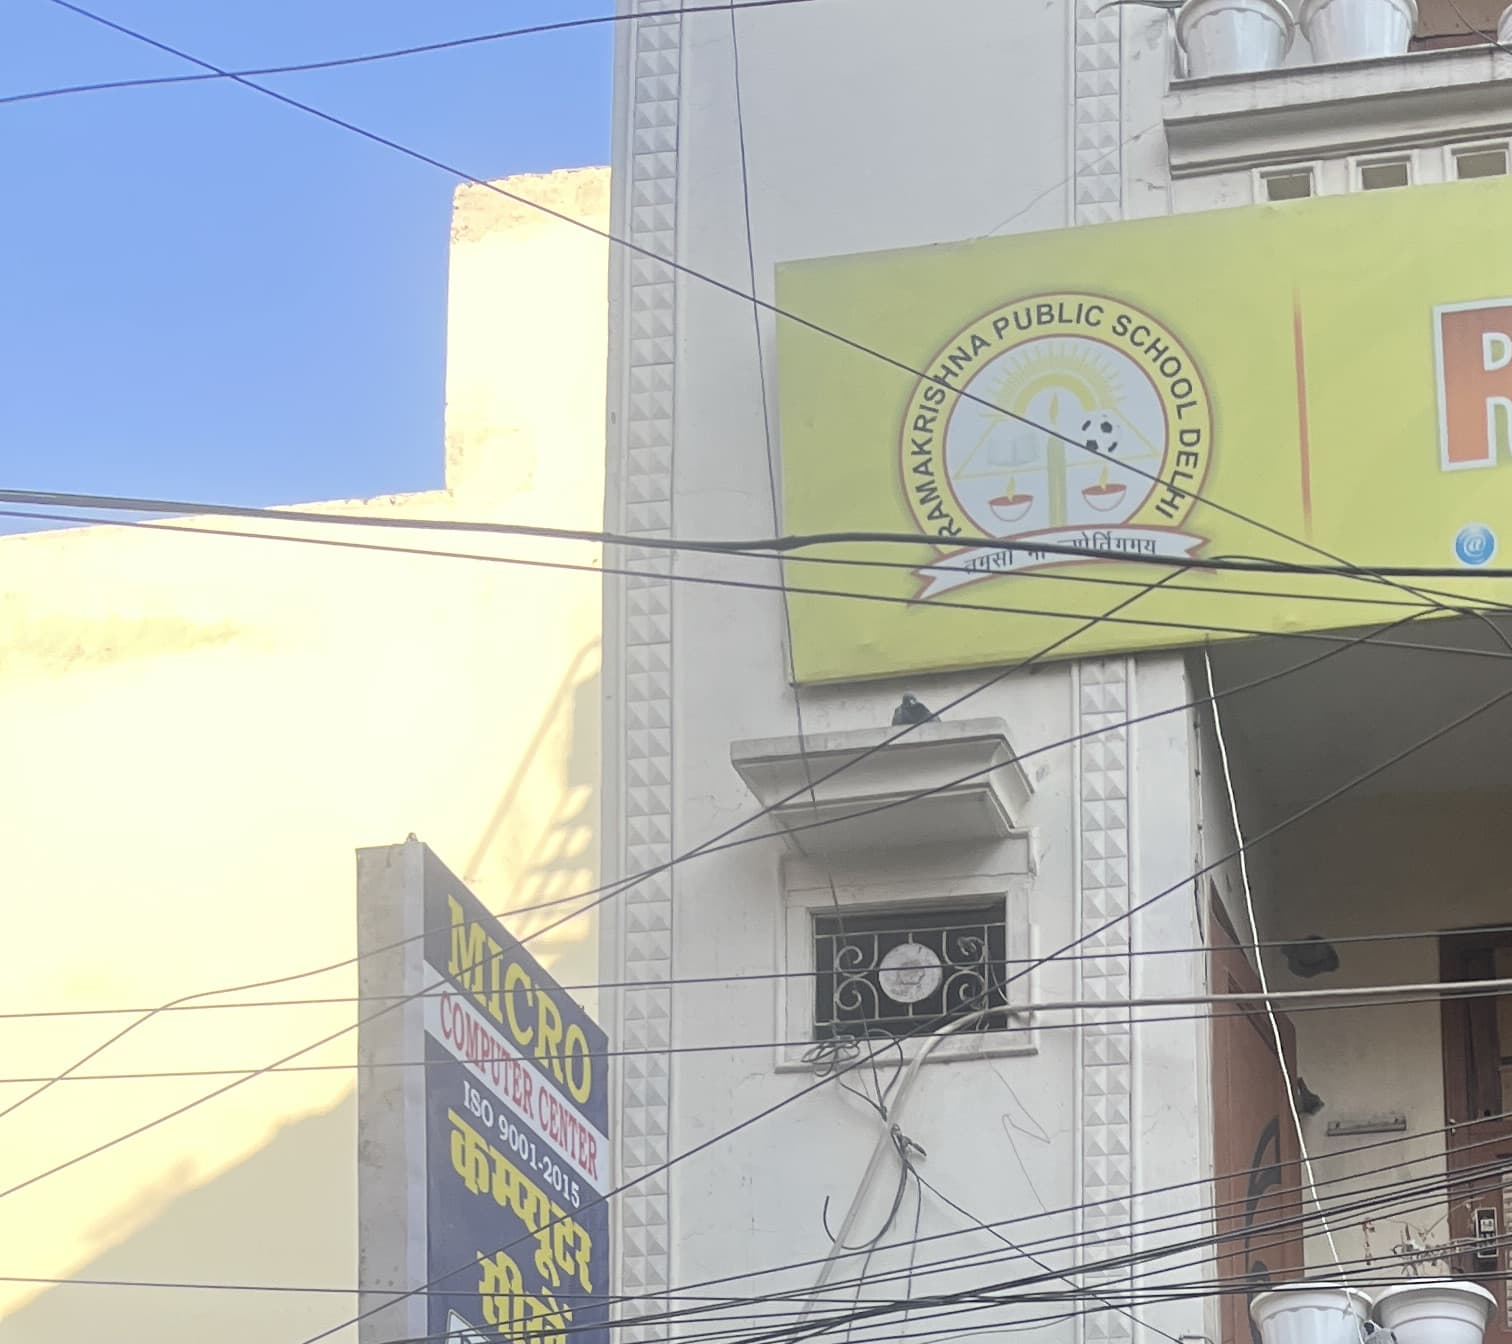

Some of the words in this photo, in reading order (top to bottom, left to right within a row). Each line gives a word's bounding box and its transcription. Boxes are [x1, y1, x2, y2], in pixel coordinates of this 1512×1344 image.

[992, 302, 1104, 340] PUBLIC
[1111, 313, 1200, 421] SCHOOL
[910, 334, 992, 538] RAMAKRISHNA
[1154, 428, 1201, 520] DELHI
[447, 893, 592, 1104] MICRO
[440, 989, 534, 1121] COMPUTER
[538, 1085, 599, 1181] CENTER
[463, 1080, 494, 1130] ISO
[498, 1113, 581, 1210] 9001-2015
